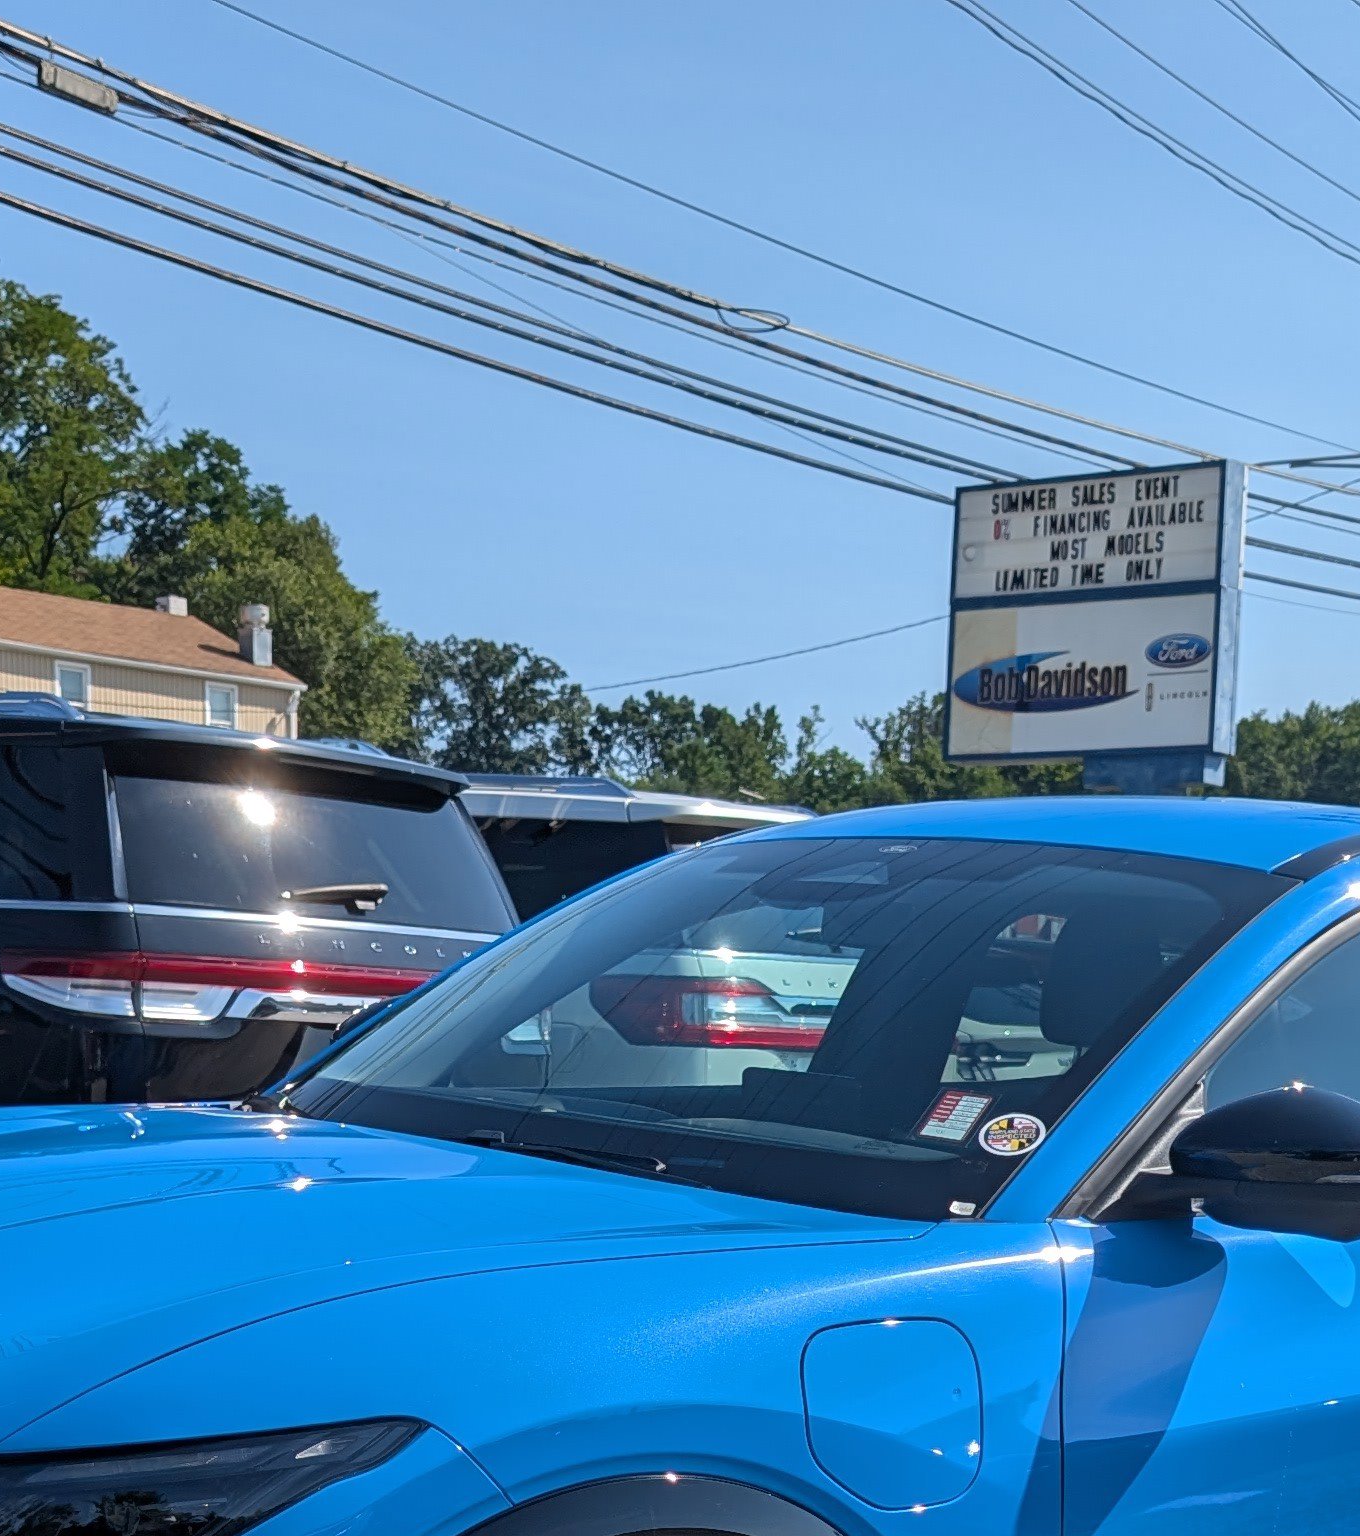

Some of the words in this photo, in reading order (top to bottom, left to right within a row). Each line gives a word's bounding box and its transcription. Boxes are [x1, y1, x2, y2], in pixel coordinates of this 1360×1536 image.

[991, 487, 1057, 515] SUMMER
[1071, 481, 1116, 507] SALES
[1135, 475, 1180, 501] EVENT
[993, 519, 1011, 541] 0%
[1033, 509, 1111, 537] FINANCING
[1127, 500, 1205, 529] AVAILABLE
[1050, 538, 1087, 561] MOST
[1104, 531, 1164, 557] MODELS
[995, 566, 1059, 592] LIMITED
[1071, 563, 1105, 586] TIME
[1126, 557, 1164, 582] ONLY
[1157, 639, 1200, 662] Ford
